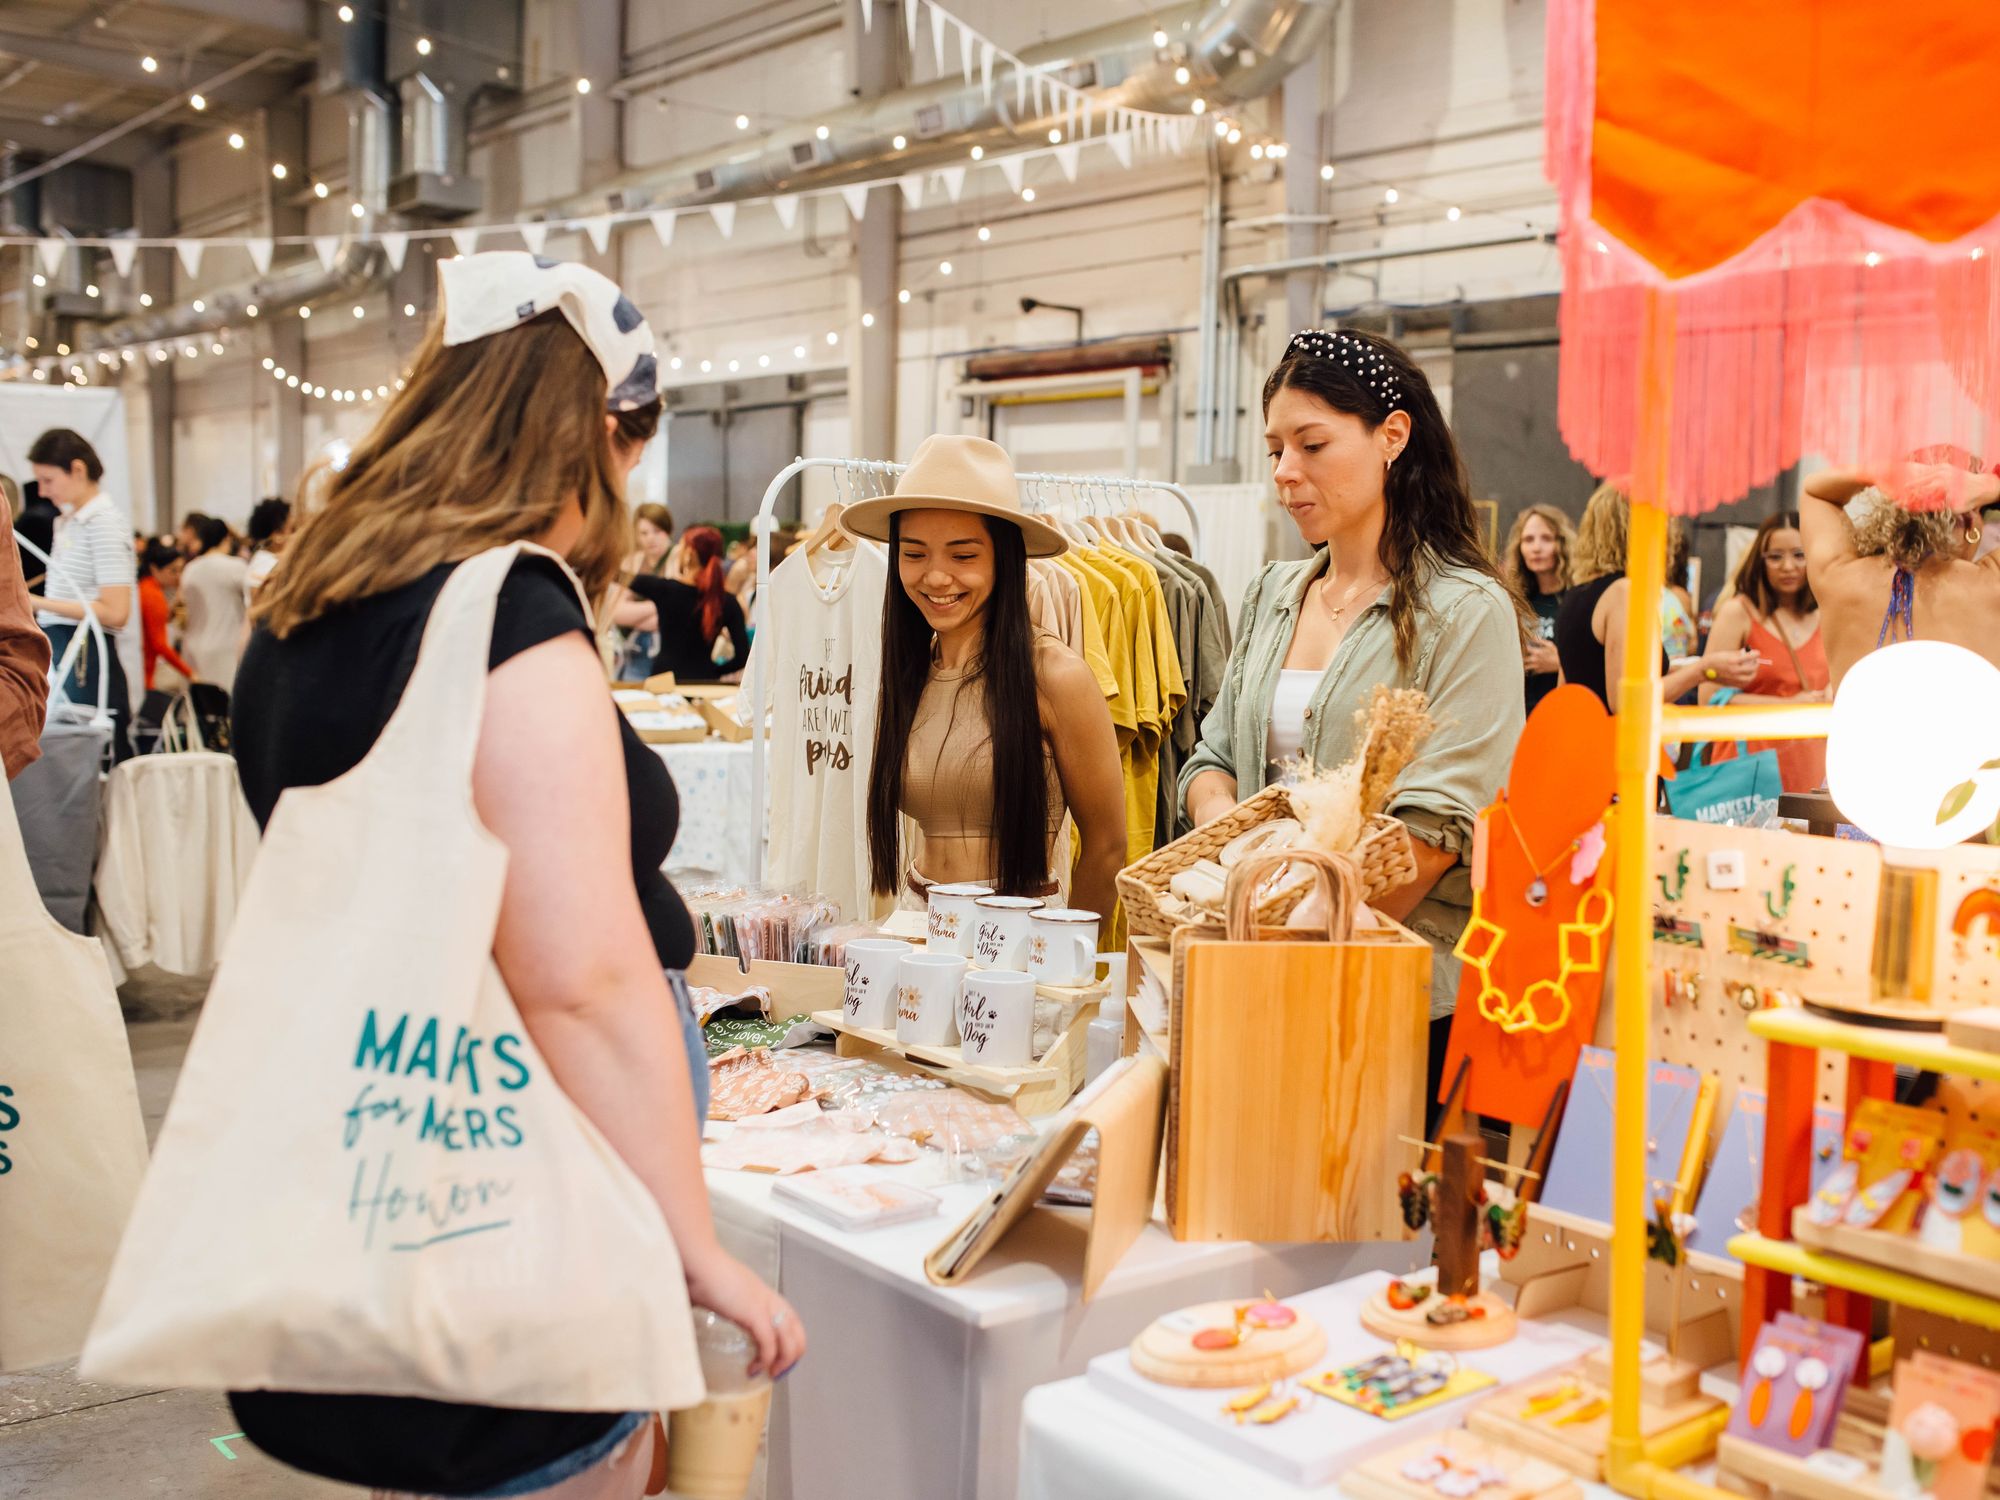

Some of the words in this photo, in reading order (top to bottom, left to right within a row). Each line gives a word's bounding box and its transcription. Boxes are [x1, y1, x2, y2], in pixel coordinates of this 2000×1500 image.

[979, 924, 998, 942] Girl
[980, 942, 1000, 962] Dog
[963, 1021, 990, 1053] Dog
